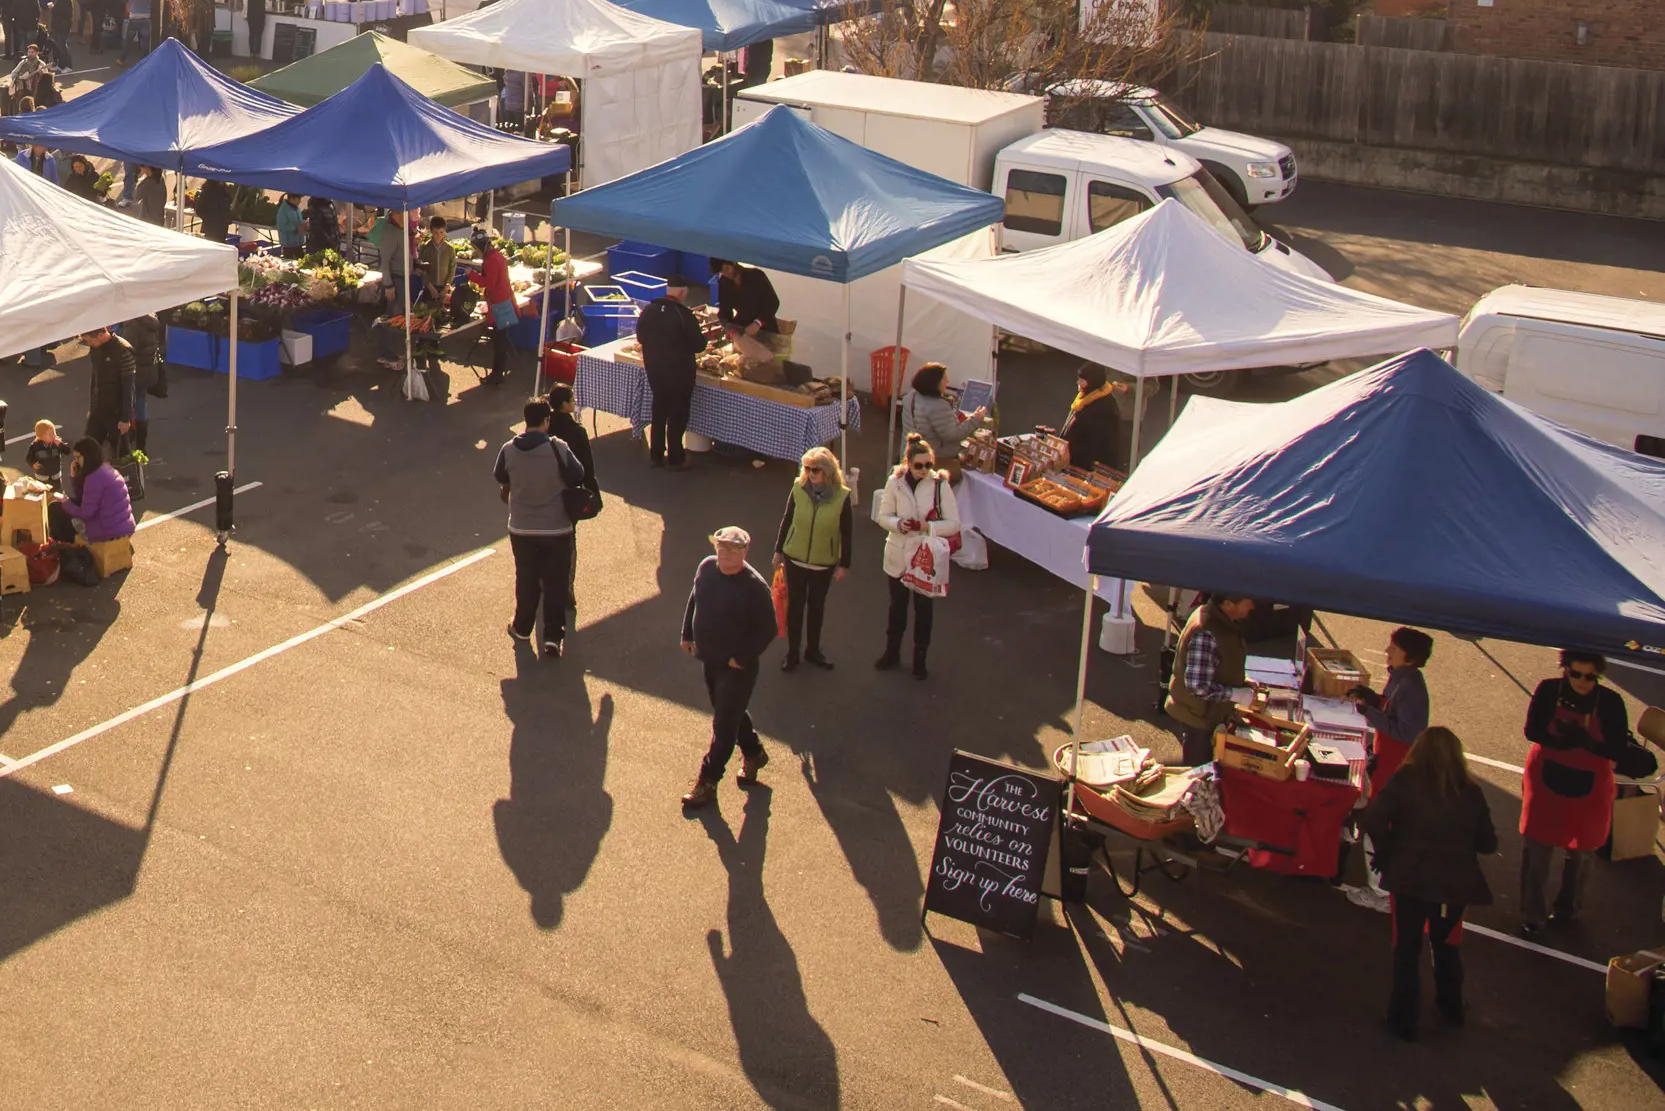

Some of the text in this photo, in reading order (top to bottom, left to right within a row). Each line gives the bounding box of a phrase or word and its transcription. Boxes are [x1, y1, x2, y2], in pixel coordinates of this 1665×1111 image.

[1092, 0, 1114, 9] CA
[949, 772, 1049, 822] Harvest
[1004, 781, 1023, 797] THE
[944, 821, 1033, 856] relies on
[956, 807, 1029, 836] COMMUNITY
[944, 835, 1029, 871] VOLUNTEERS
[936, 856, 1038, 912] Sign up here
